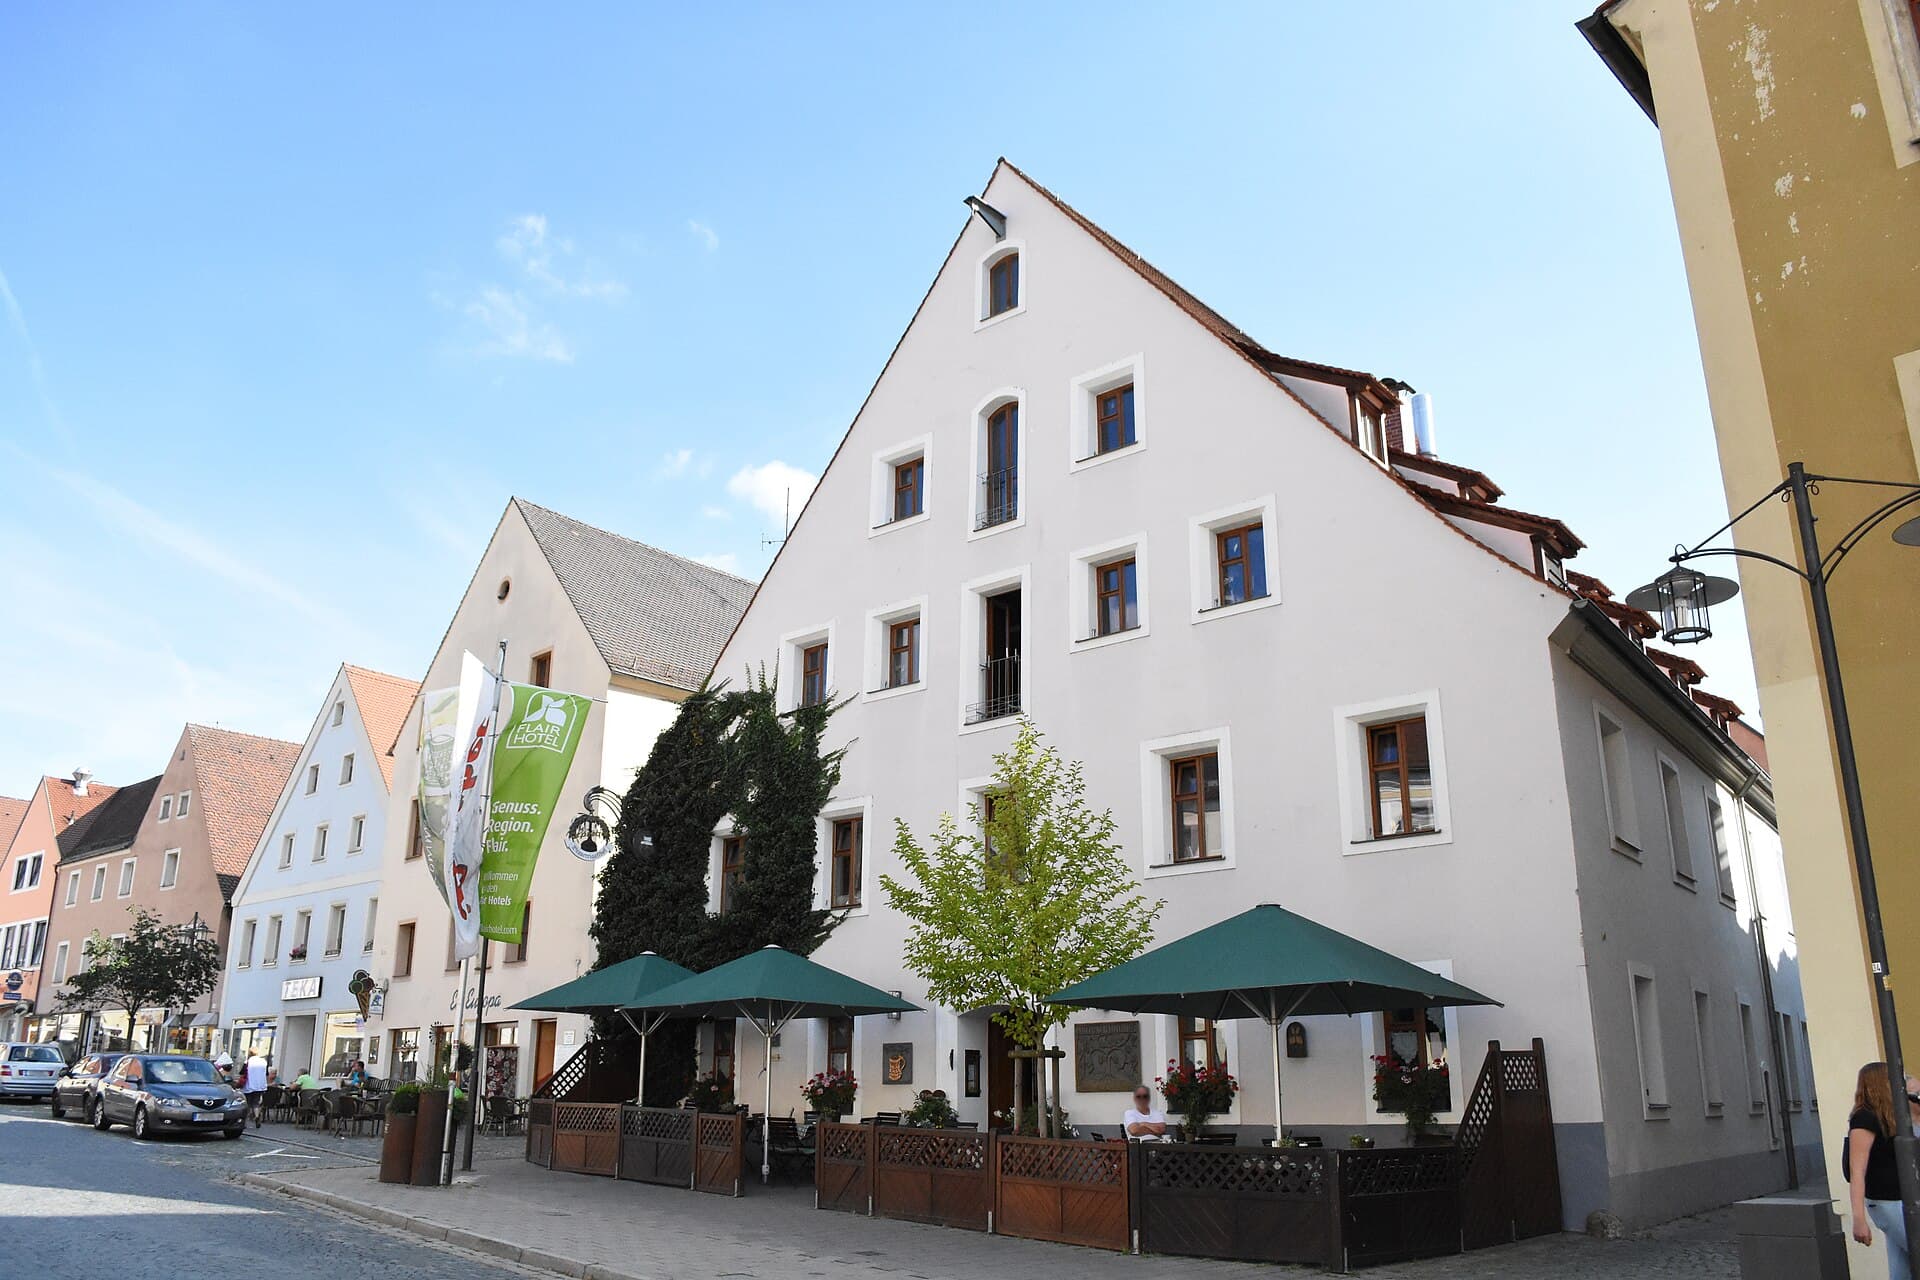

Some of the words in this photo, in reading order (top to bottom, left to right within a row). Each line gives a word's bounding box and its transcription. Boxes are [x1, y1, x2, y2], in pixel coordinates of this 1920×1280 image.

[517, 723, 561, 736] FLAIR
[513, 733, 559, 747] HOTEL
[492, 800, 542, 815] Genuss.
[487, 817, 534, 836] Region.
[486, 837, 508, 853] Flair.
[488, 896, 512, 906] Hotels
[284, 978, 317, 998] TEKA
[465, 988, 502, 1016] Euopa
